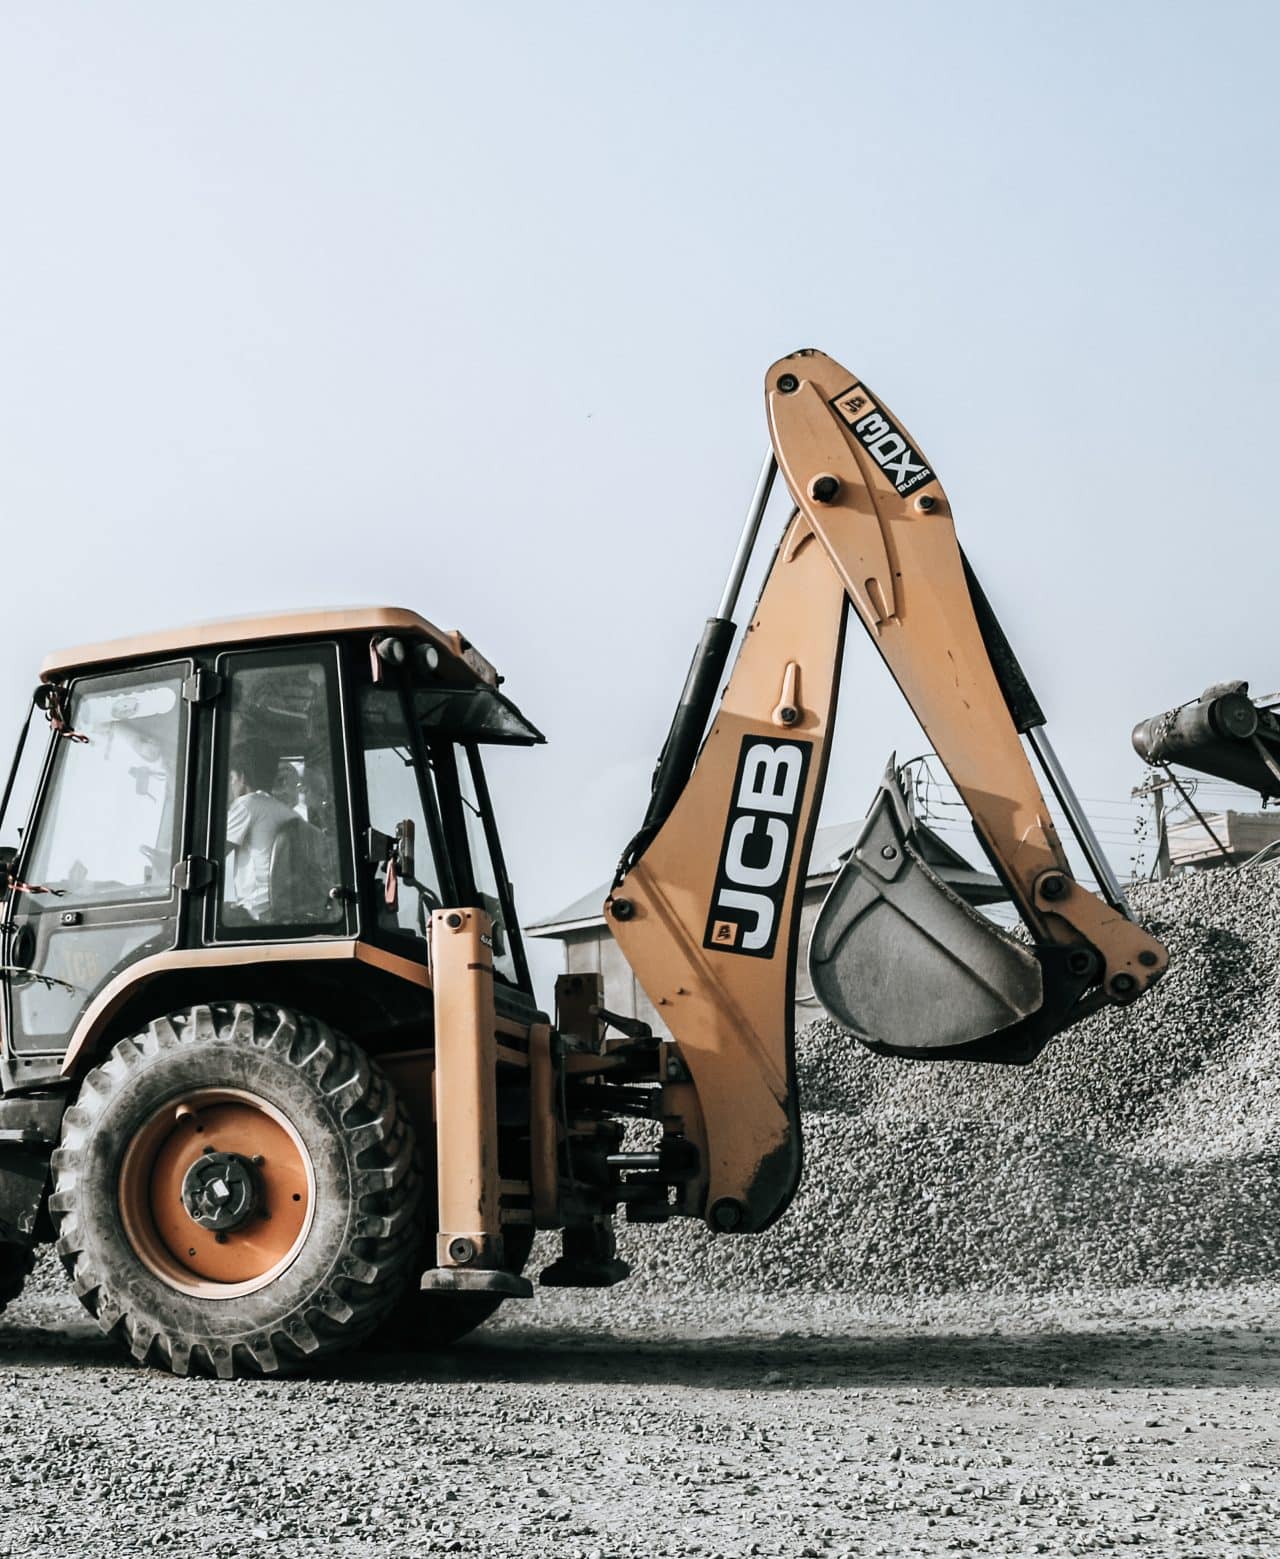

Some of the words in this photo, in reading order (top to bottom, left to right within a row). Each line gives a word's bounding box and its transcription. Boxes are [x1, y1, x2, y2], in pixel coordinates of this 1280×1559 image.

[856, 412, 926, 486] 3DX
[897, 468, 931, 492] SUPER
[717, 743, 803, 950] JCB
